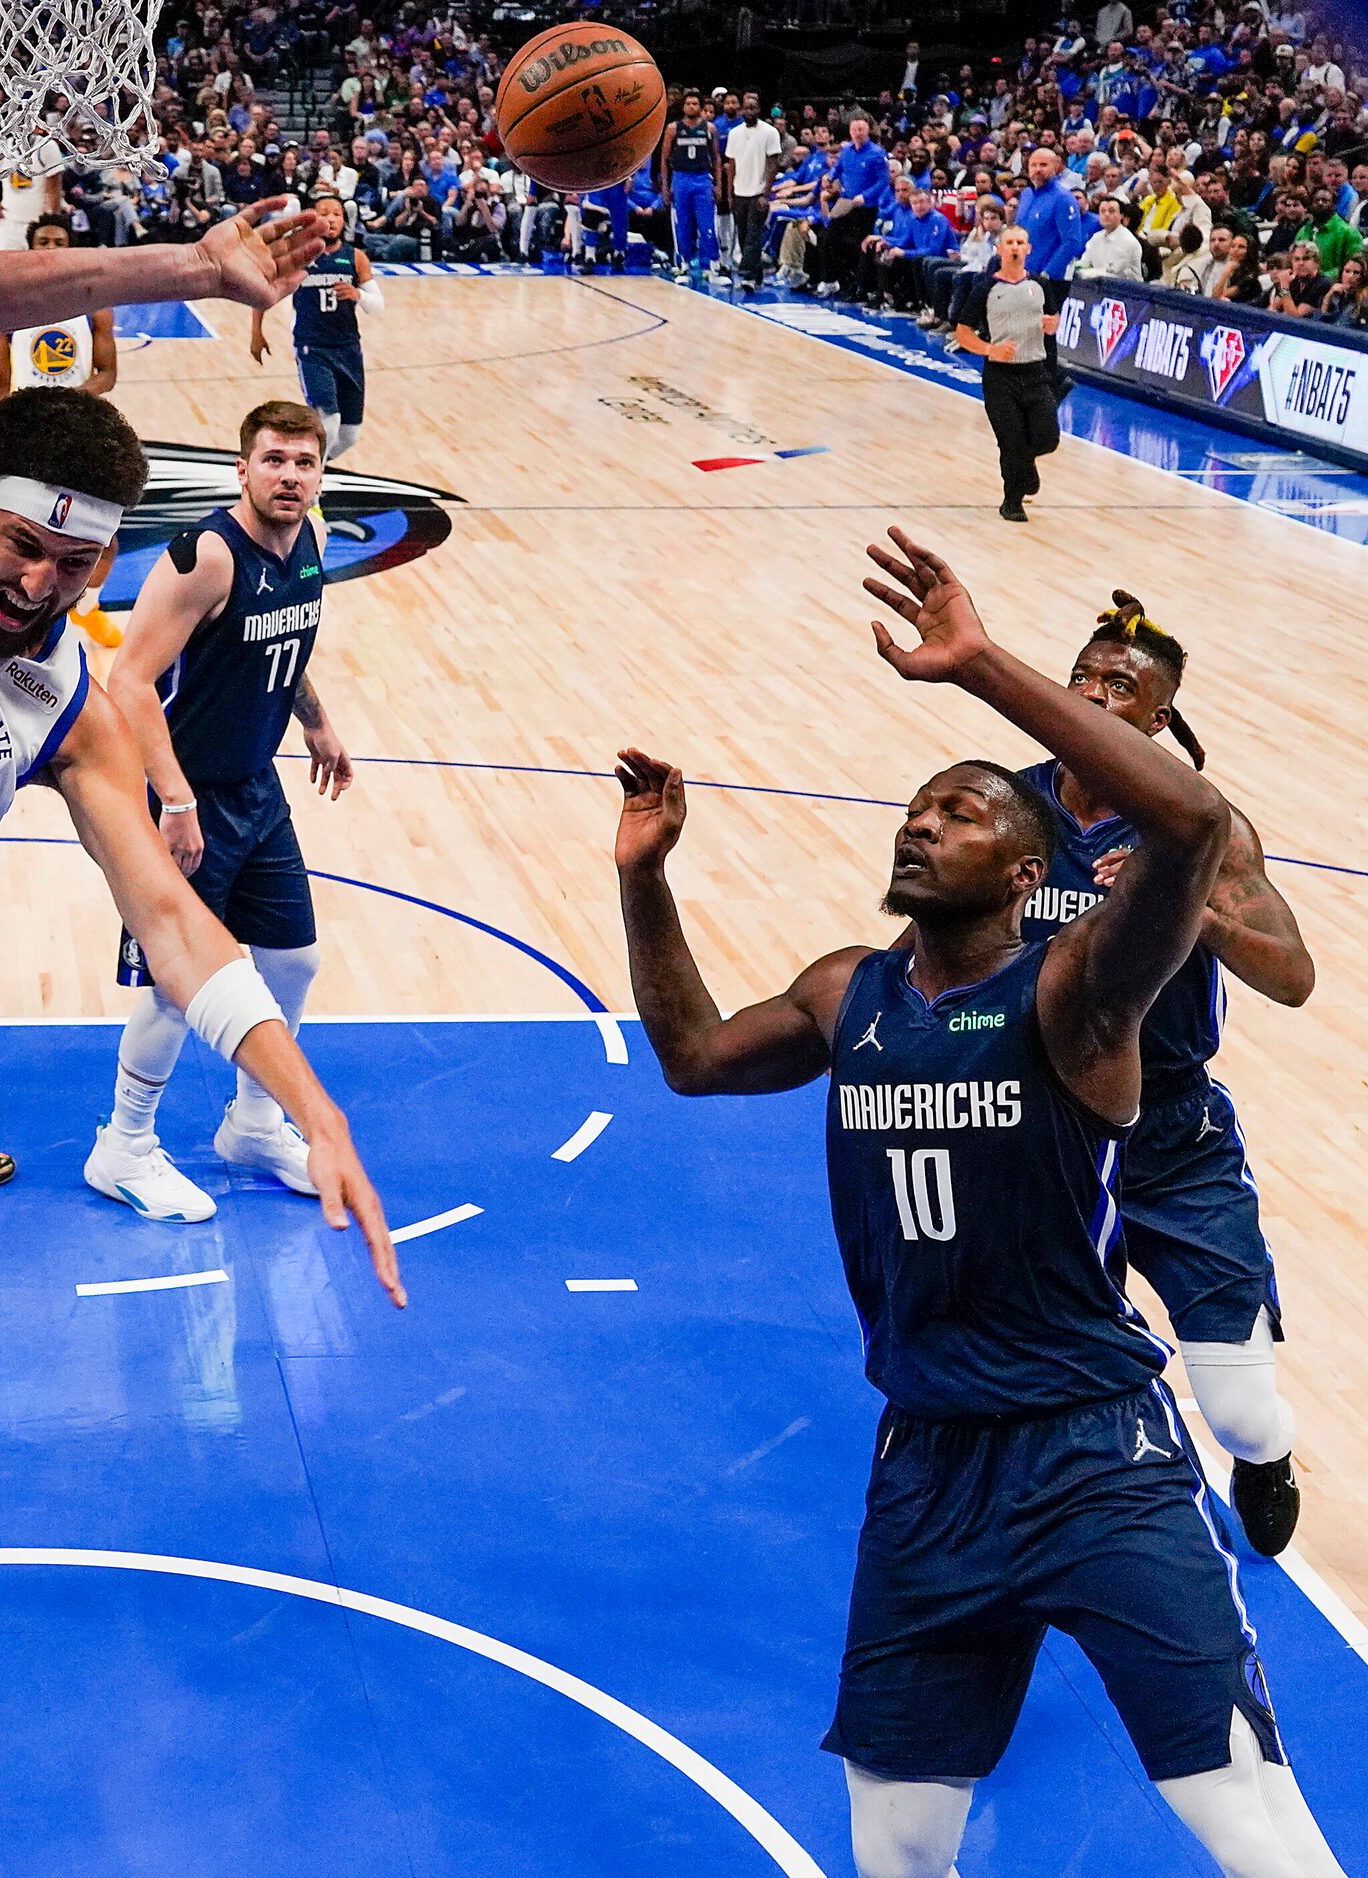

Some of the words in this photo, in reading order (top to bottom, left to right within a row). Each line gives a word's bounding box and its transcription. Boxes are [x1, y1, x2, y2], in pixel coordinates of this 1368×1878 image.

[517, 39, 631, 93] Wilson
[1134, 318, 1193, 381] #NBA75
[1284, 358, 1356, 425] #NBA75
[5, 661, 59, 709] Rakuten
[265, 638, 301, 693] 77
[948, 1010, 1006, 1032] chime
[838, 1080, 1022, 1131] MAVERICKS
[885, 1148, 957, 1242] 10
